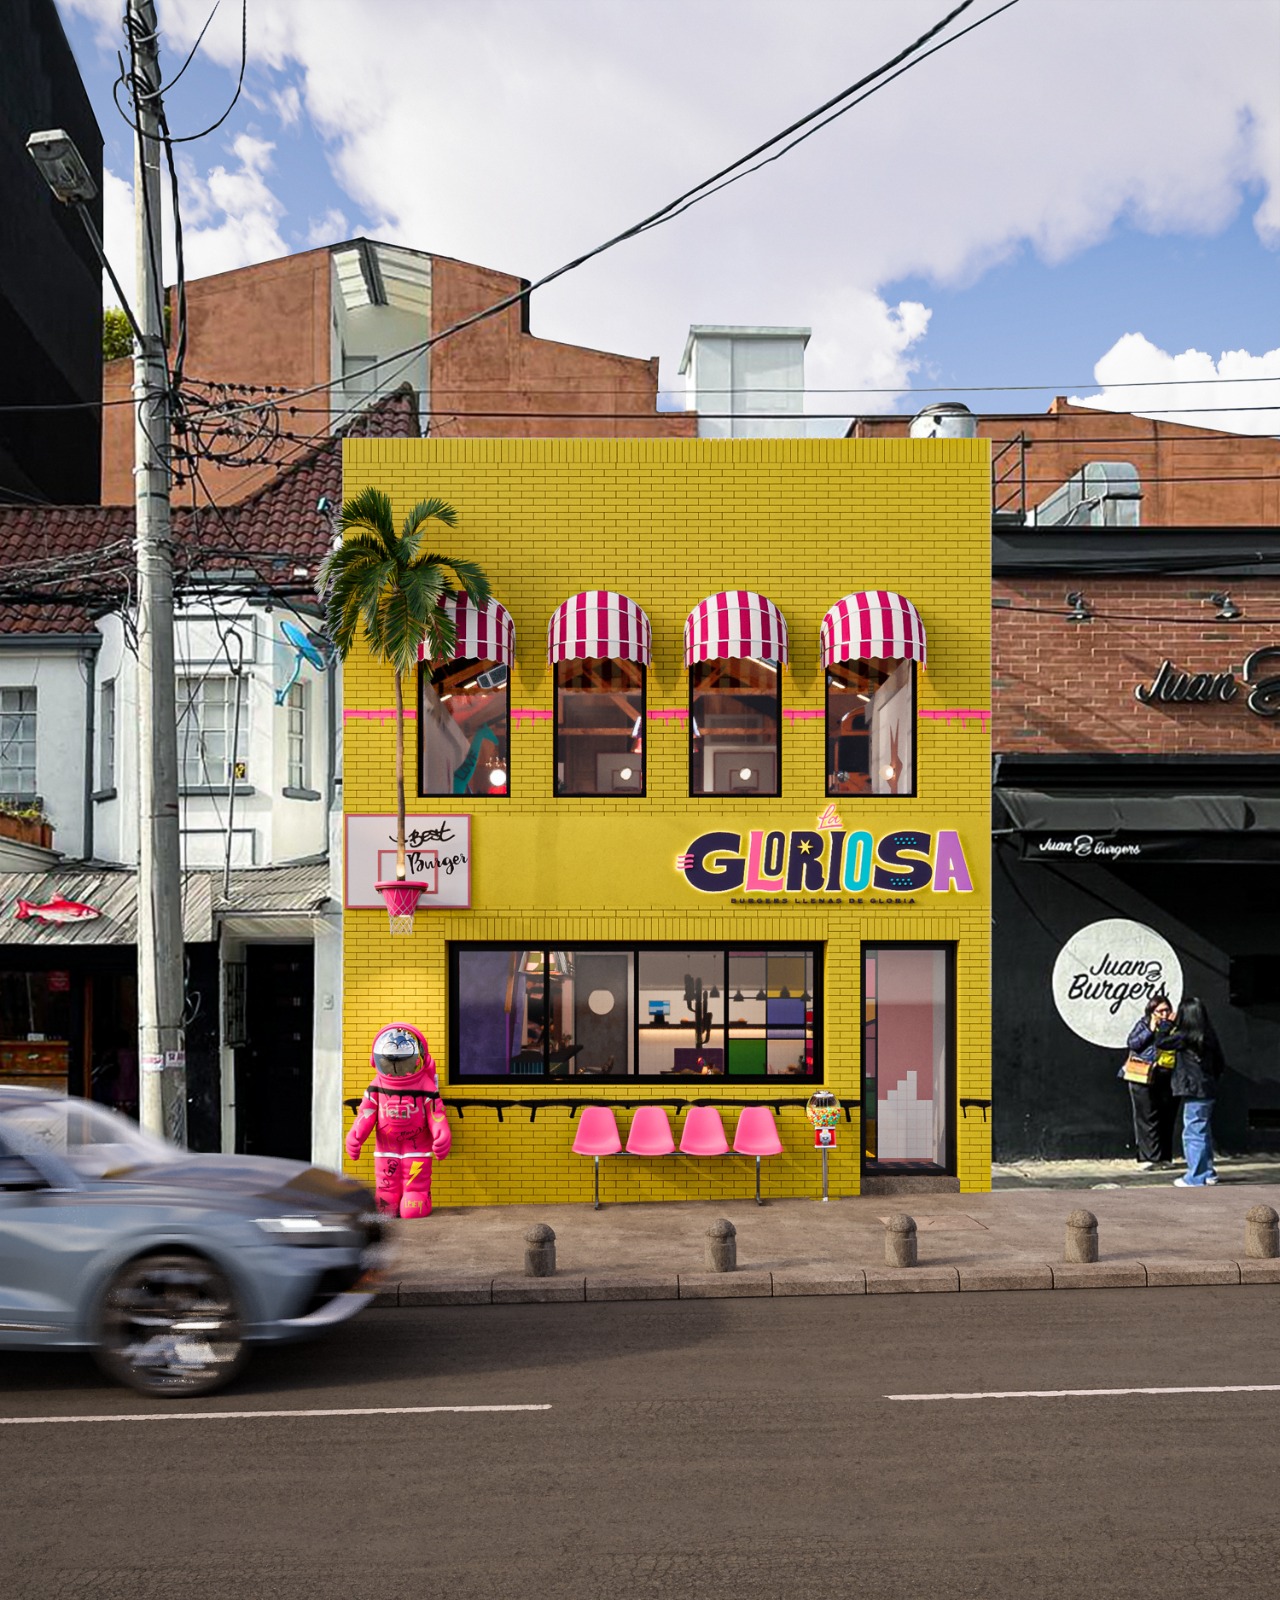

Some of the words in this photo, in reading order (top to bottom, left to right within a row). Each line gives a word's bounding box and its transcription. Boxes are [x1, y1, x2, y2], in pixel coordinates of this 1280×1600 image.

[1134, 659, 1238, 702] Juan
[400, 821, 456, 848] Best
[1039, 837, 1072, 851] Juan
[407, 851, 469, 875] Burger
[682, 830, 974, 892] GLORIOSA
[1089, 953, 1147, 977] Juan
[1067, 973, 1169, 1015] Burgers
